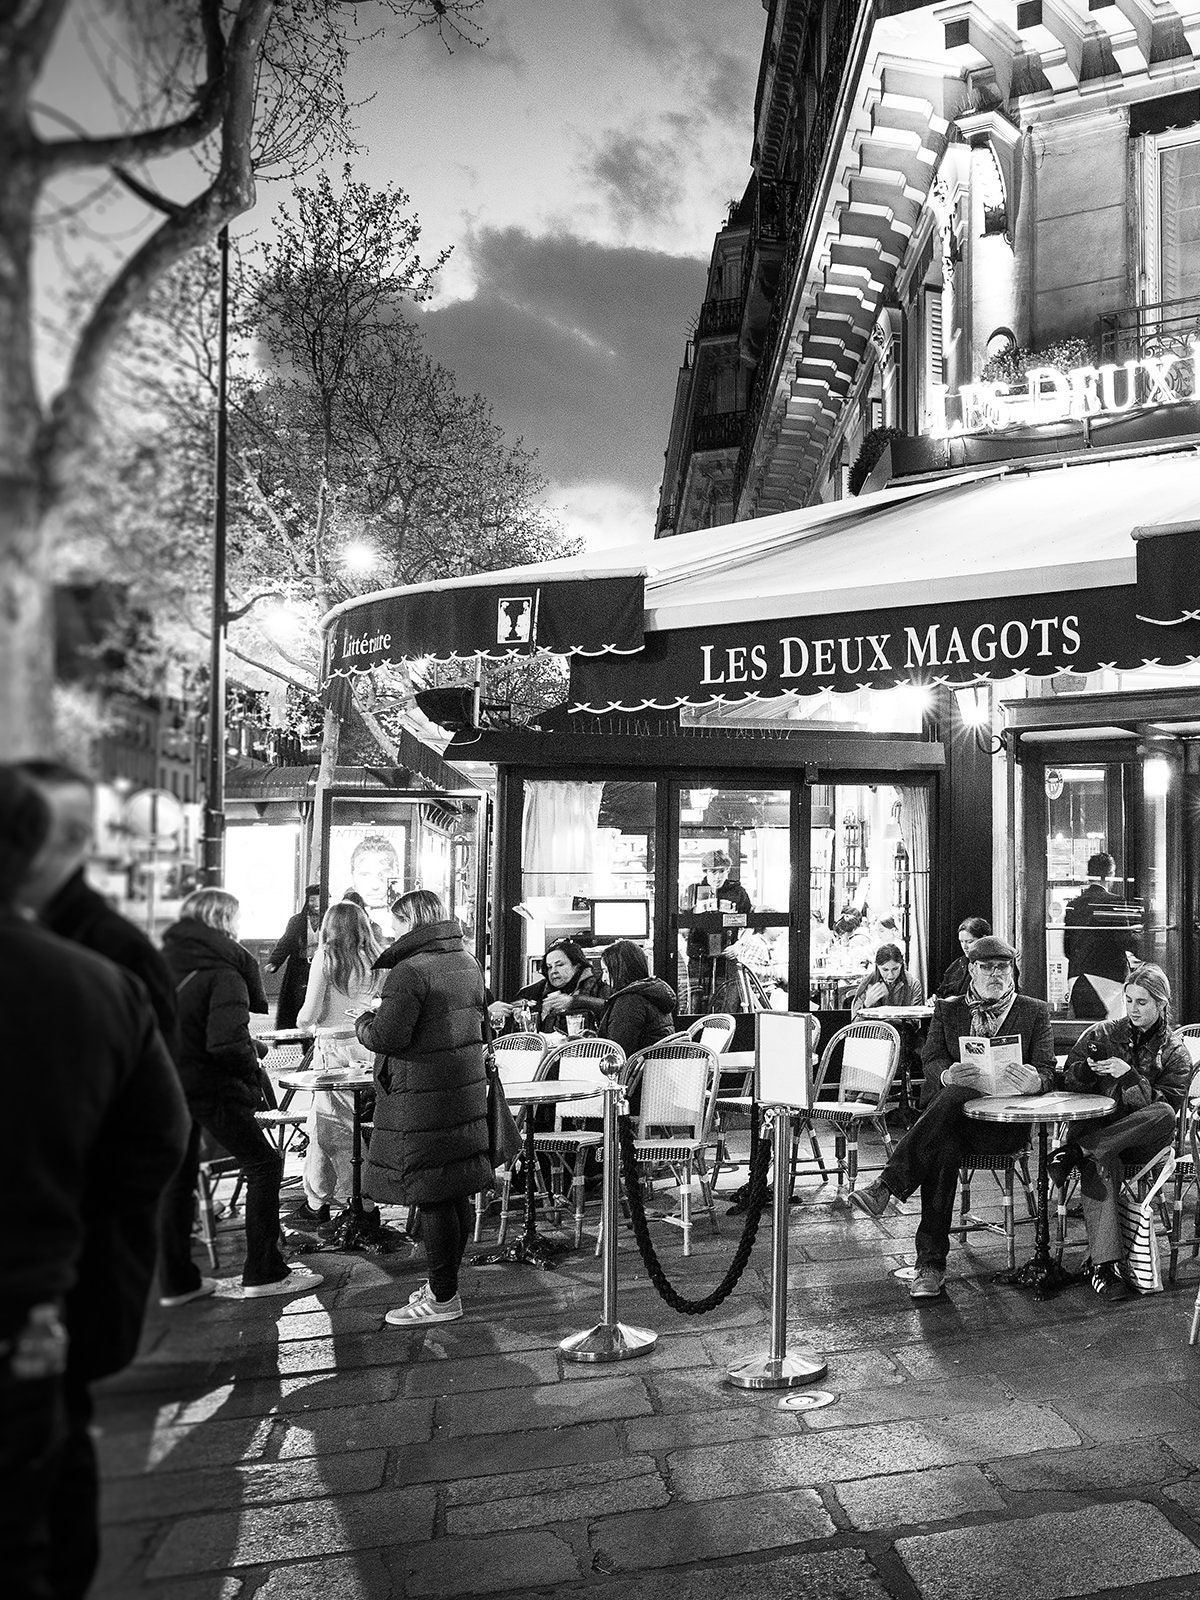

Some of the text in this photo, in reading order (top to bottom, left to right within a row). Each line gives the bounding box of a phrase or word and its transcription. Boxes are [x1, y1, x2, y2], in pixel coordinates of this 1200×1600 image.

[1024, 354, 1180, 430] DEUX
[699, 615, 1081, 685] LES DEUX MAGOTS
